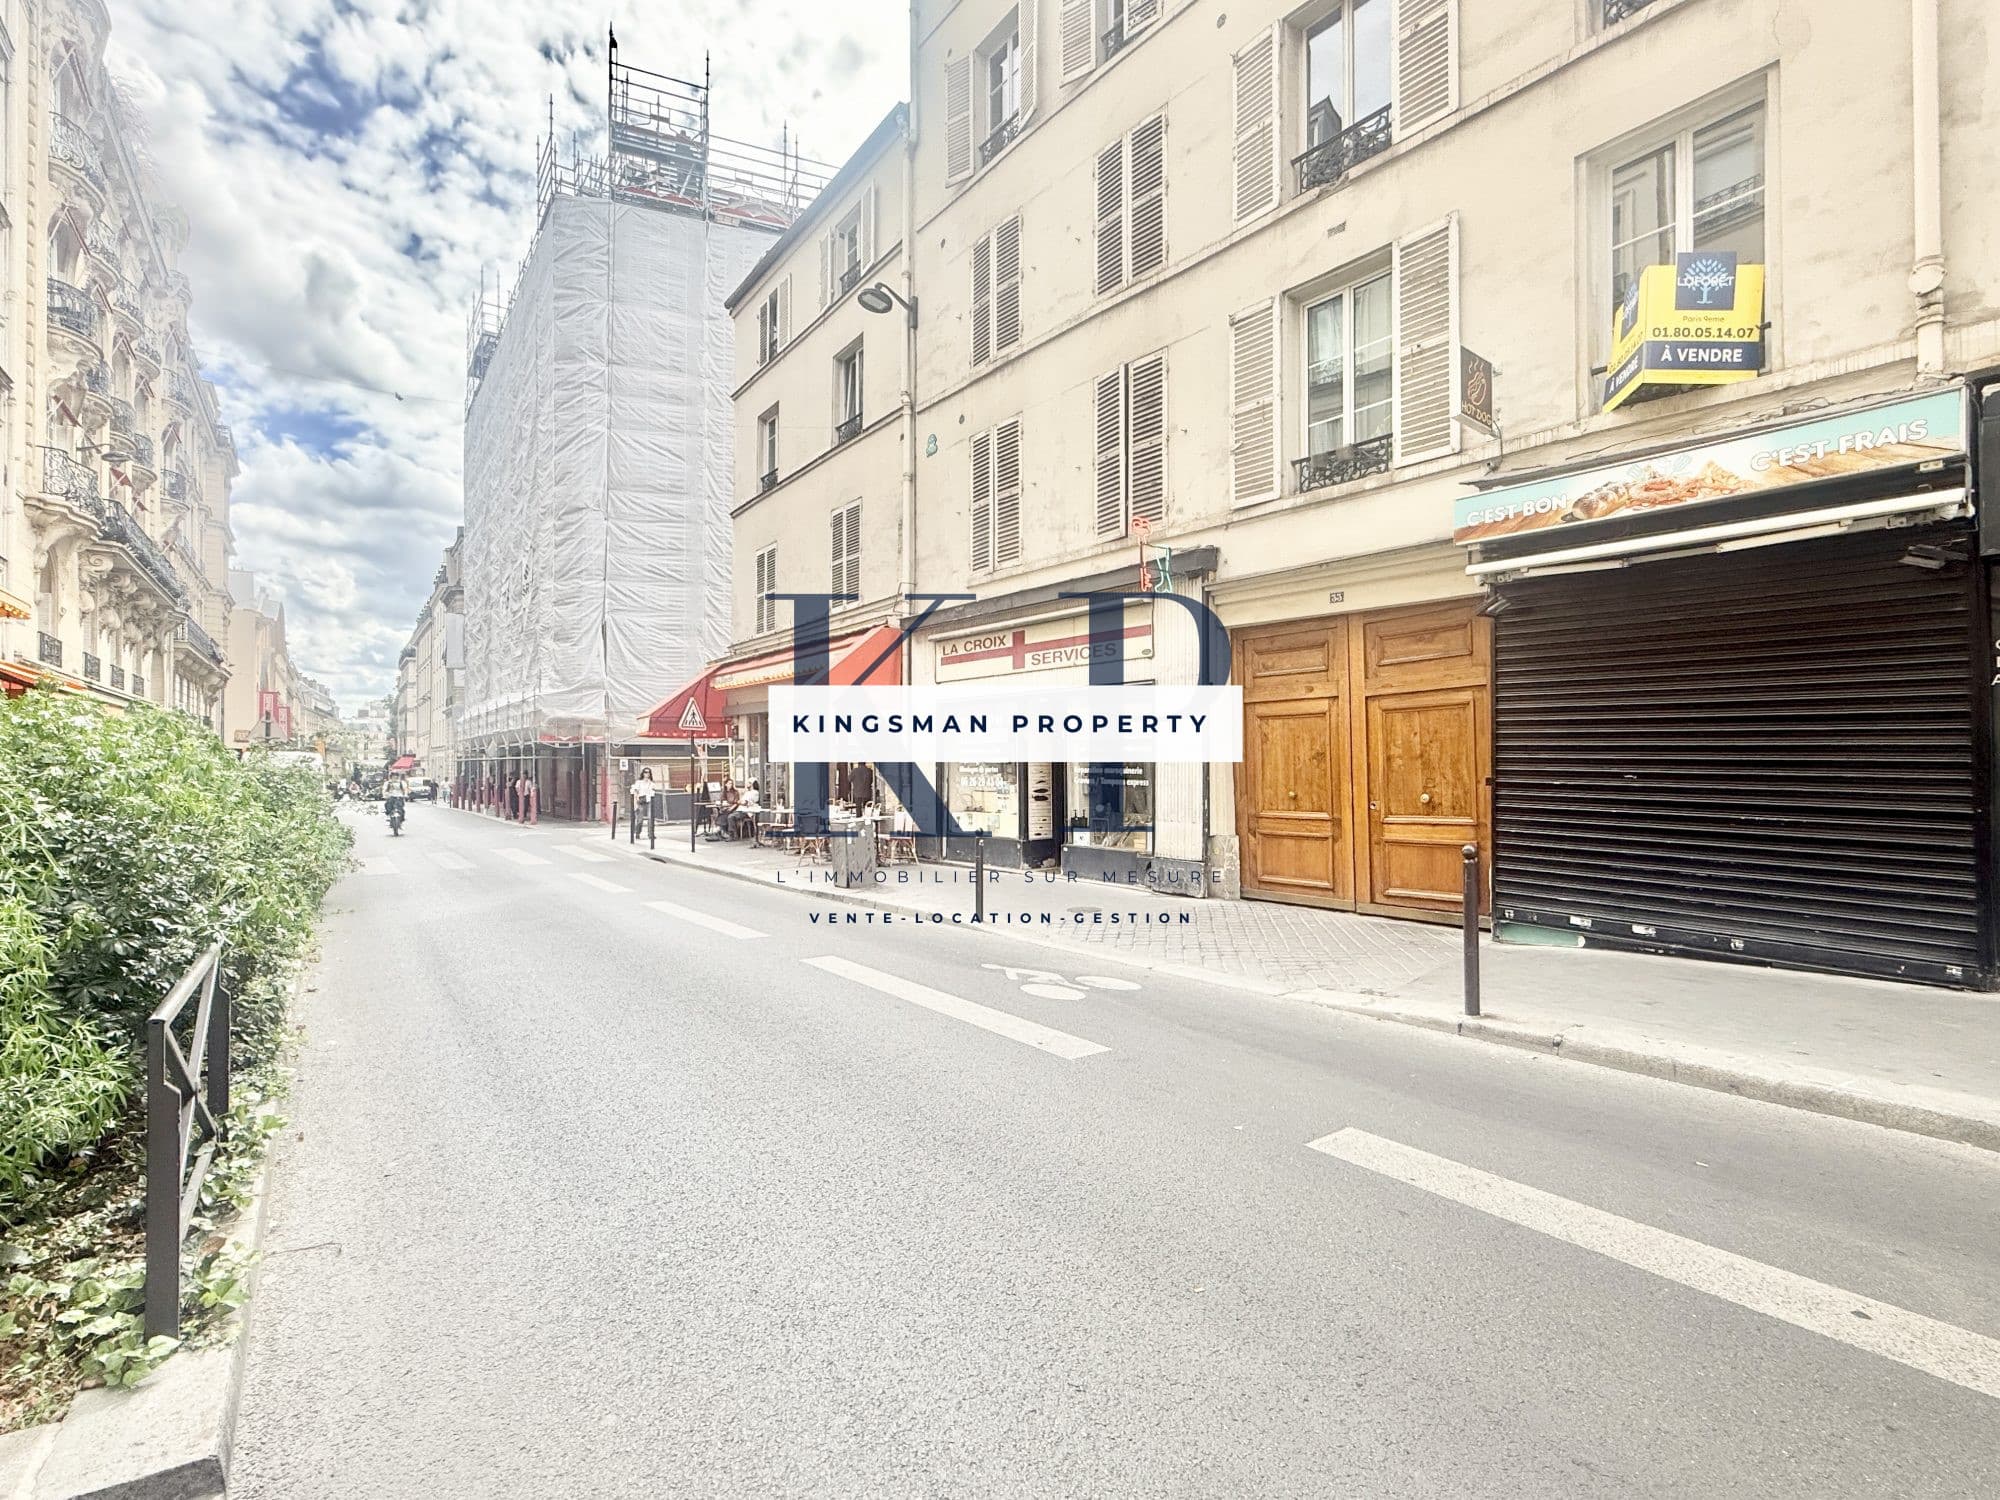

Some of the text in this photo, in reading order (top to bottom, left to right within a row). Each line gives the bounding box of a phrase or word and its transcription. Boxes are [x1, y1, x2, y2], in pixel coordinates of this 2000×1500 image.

[1652, 327, 1755, 338] 01.80.05.14.07
[1660, 344, 1743, 362] À VENDRE
[1461, 400, 1492, 425] HOT DOG
[1750, 417, 1929, 473] C'EST FRAIS
[1466, 494, 1568, 528] C'EST BON
[942, 635, 1007, 656] LA CROIX
[1031, 643, 1117, 666] SERVICES
